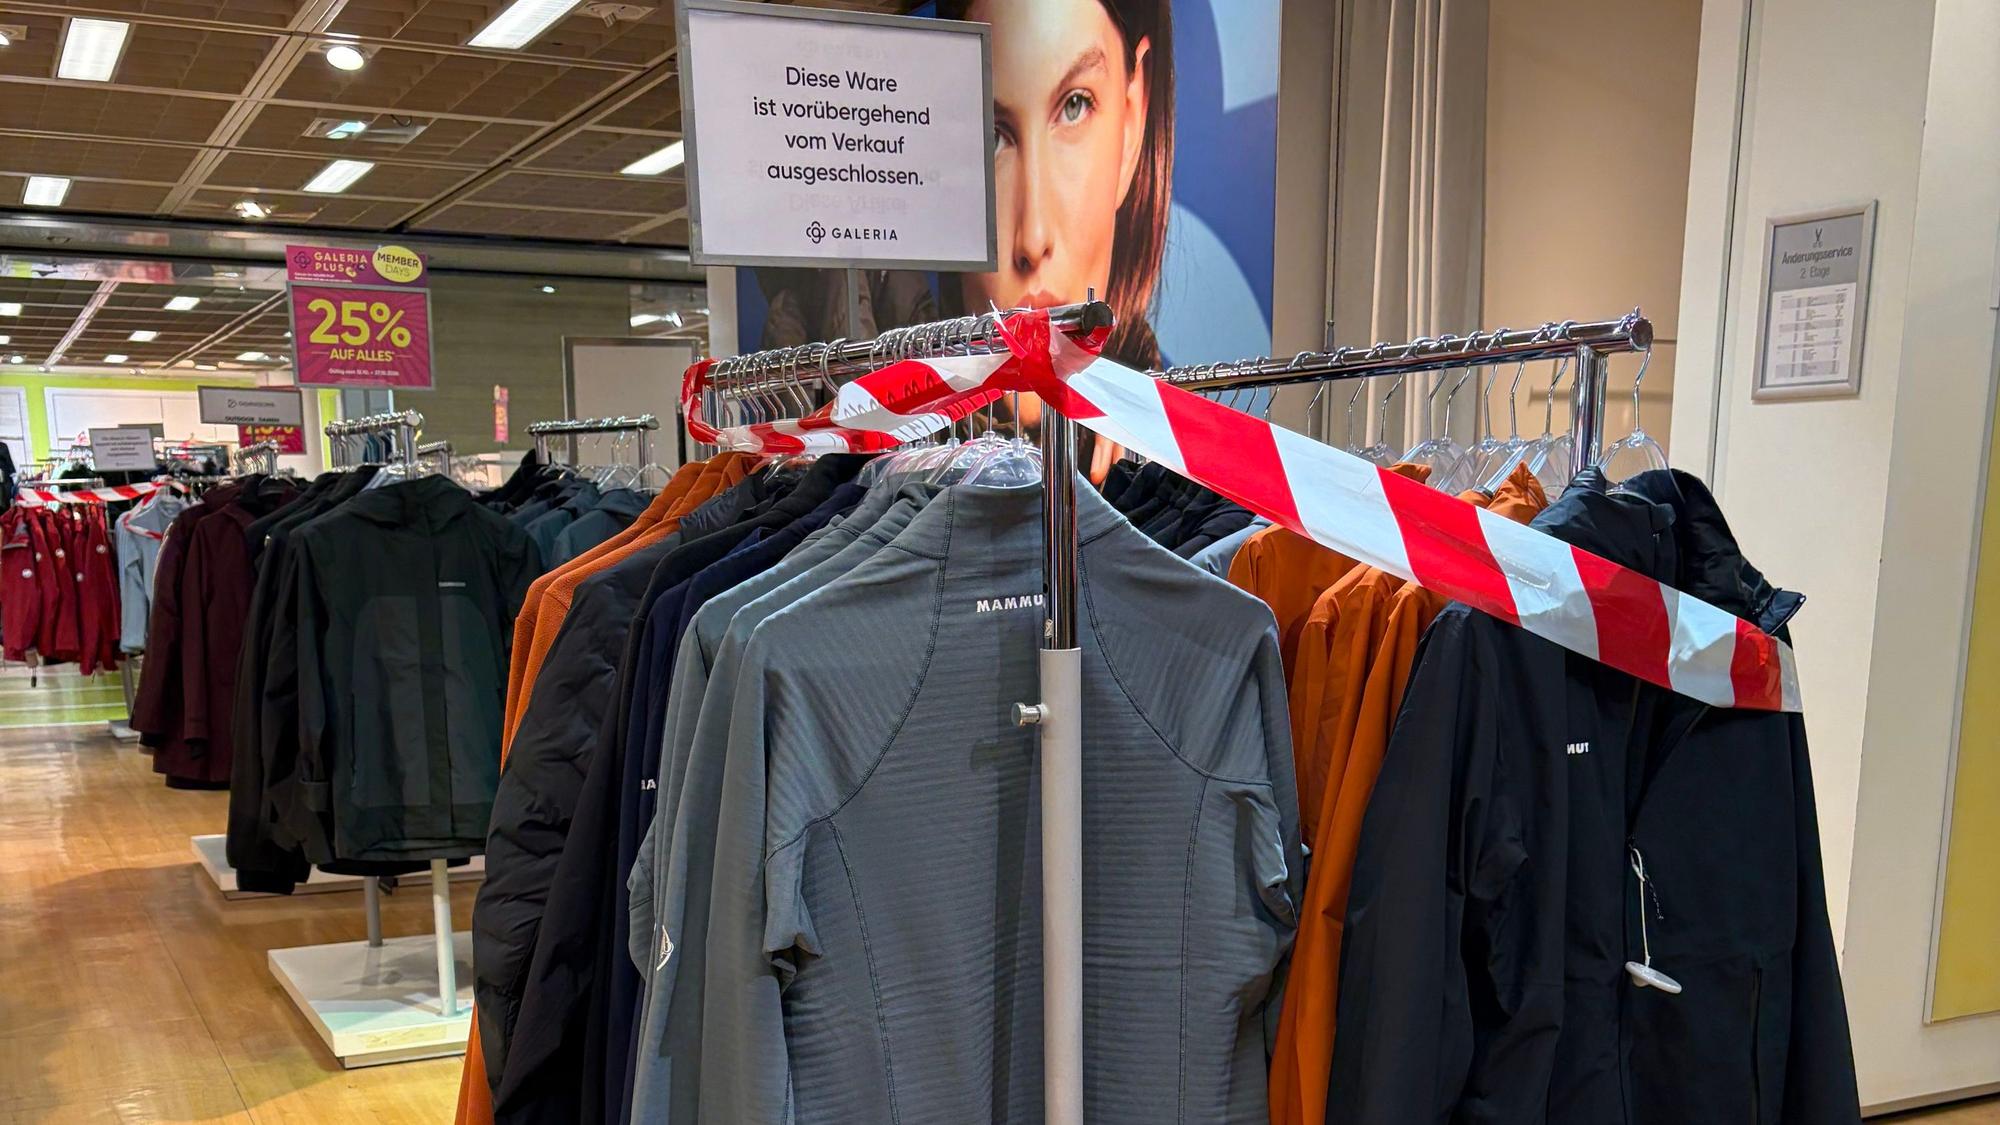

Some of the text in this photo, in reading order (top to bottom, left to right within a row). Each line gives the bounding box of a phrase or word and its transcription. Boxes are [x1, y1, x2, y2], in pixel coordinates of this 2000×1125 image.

[786, 66, 898, 93] Diese Ware
[753, 96, 931, 127] ist vorübergehend
[784, 132, 905, 155] vom Verkauf
[767, 162, 924, 186] ausgeschlossen.
[831, 227, 898, 241] GALERIA
[313, 251, 368, 264] GALERIA
[377, 252, 419, 268] MEMBER
[315, 262, 345, 272] PLUS
[384, 264, 411, 278] DAYS
[307, 298, 412, 348] 25%
[330, 348, 355, 360] AUF
[976, 594, 1043, 613] MAMMU
[1566, 742, 1589, 755] MUT
